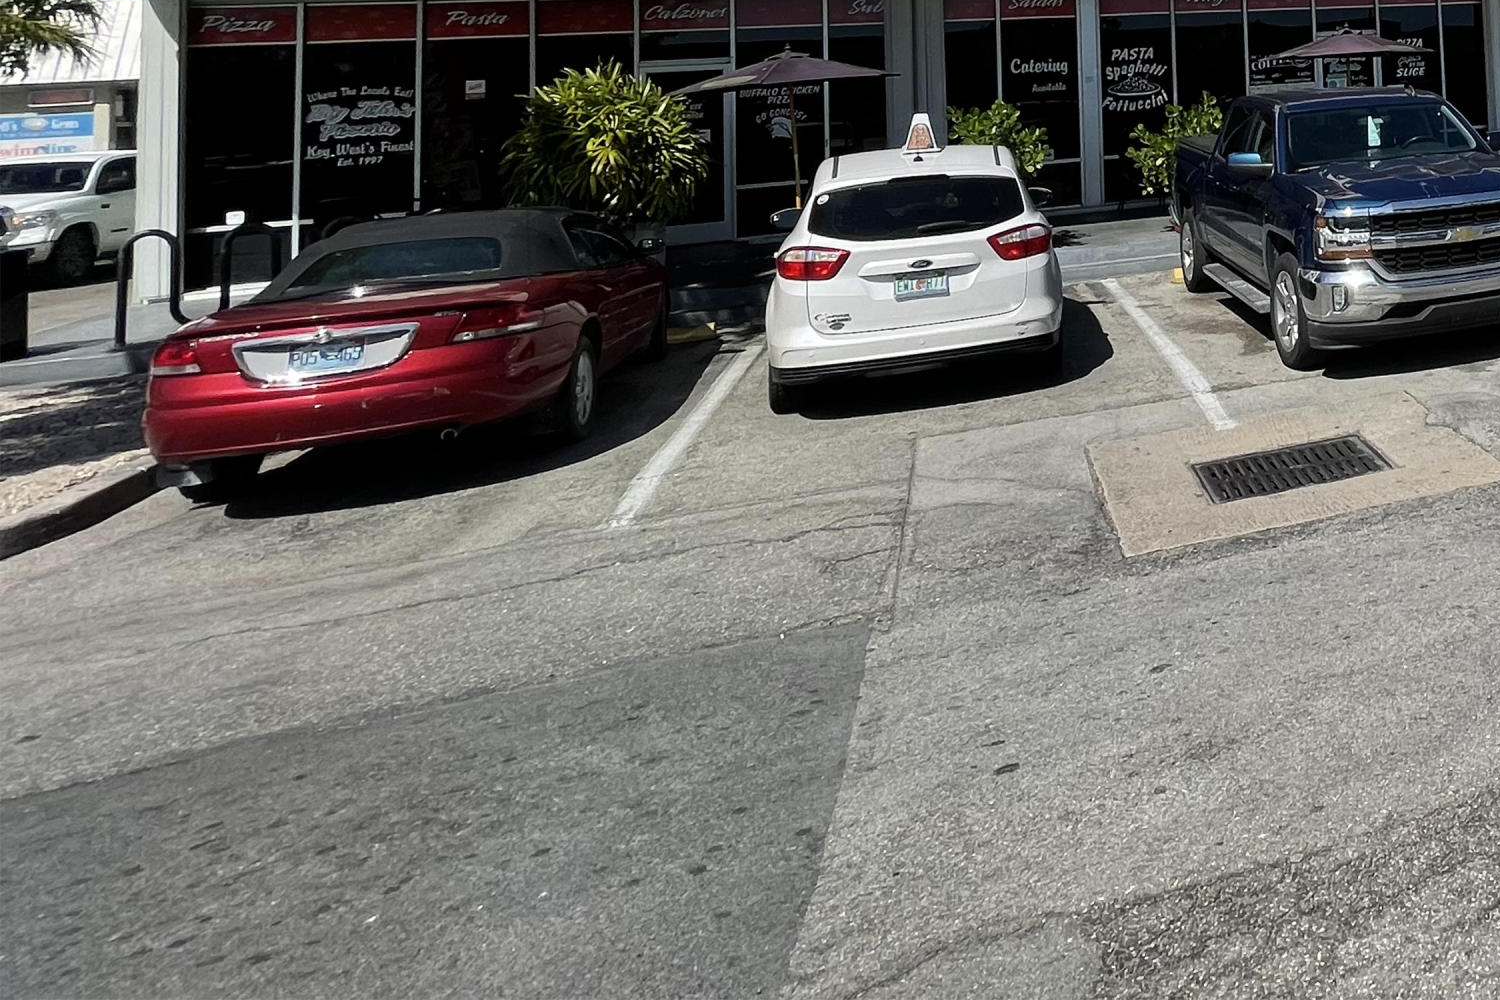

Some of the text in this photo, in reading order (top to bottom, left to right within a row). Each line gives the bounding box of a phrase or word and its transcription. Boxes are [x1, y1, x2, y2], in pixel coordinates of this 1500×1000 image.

[200, 15, 276, 33] Pizza
[445, 11, 509, 25] Pasta
[1111, 47, 1154, 61] PASTA
[1010, 58, 1068, 75] Catering
[1106, 60, 1168, 80] Spaghetti
[1396, 68, 1426, 78] SLICE
[781, 85, 820, 96] CICKEN
[767, 96, 791, 105] PIZZ
